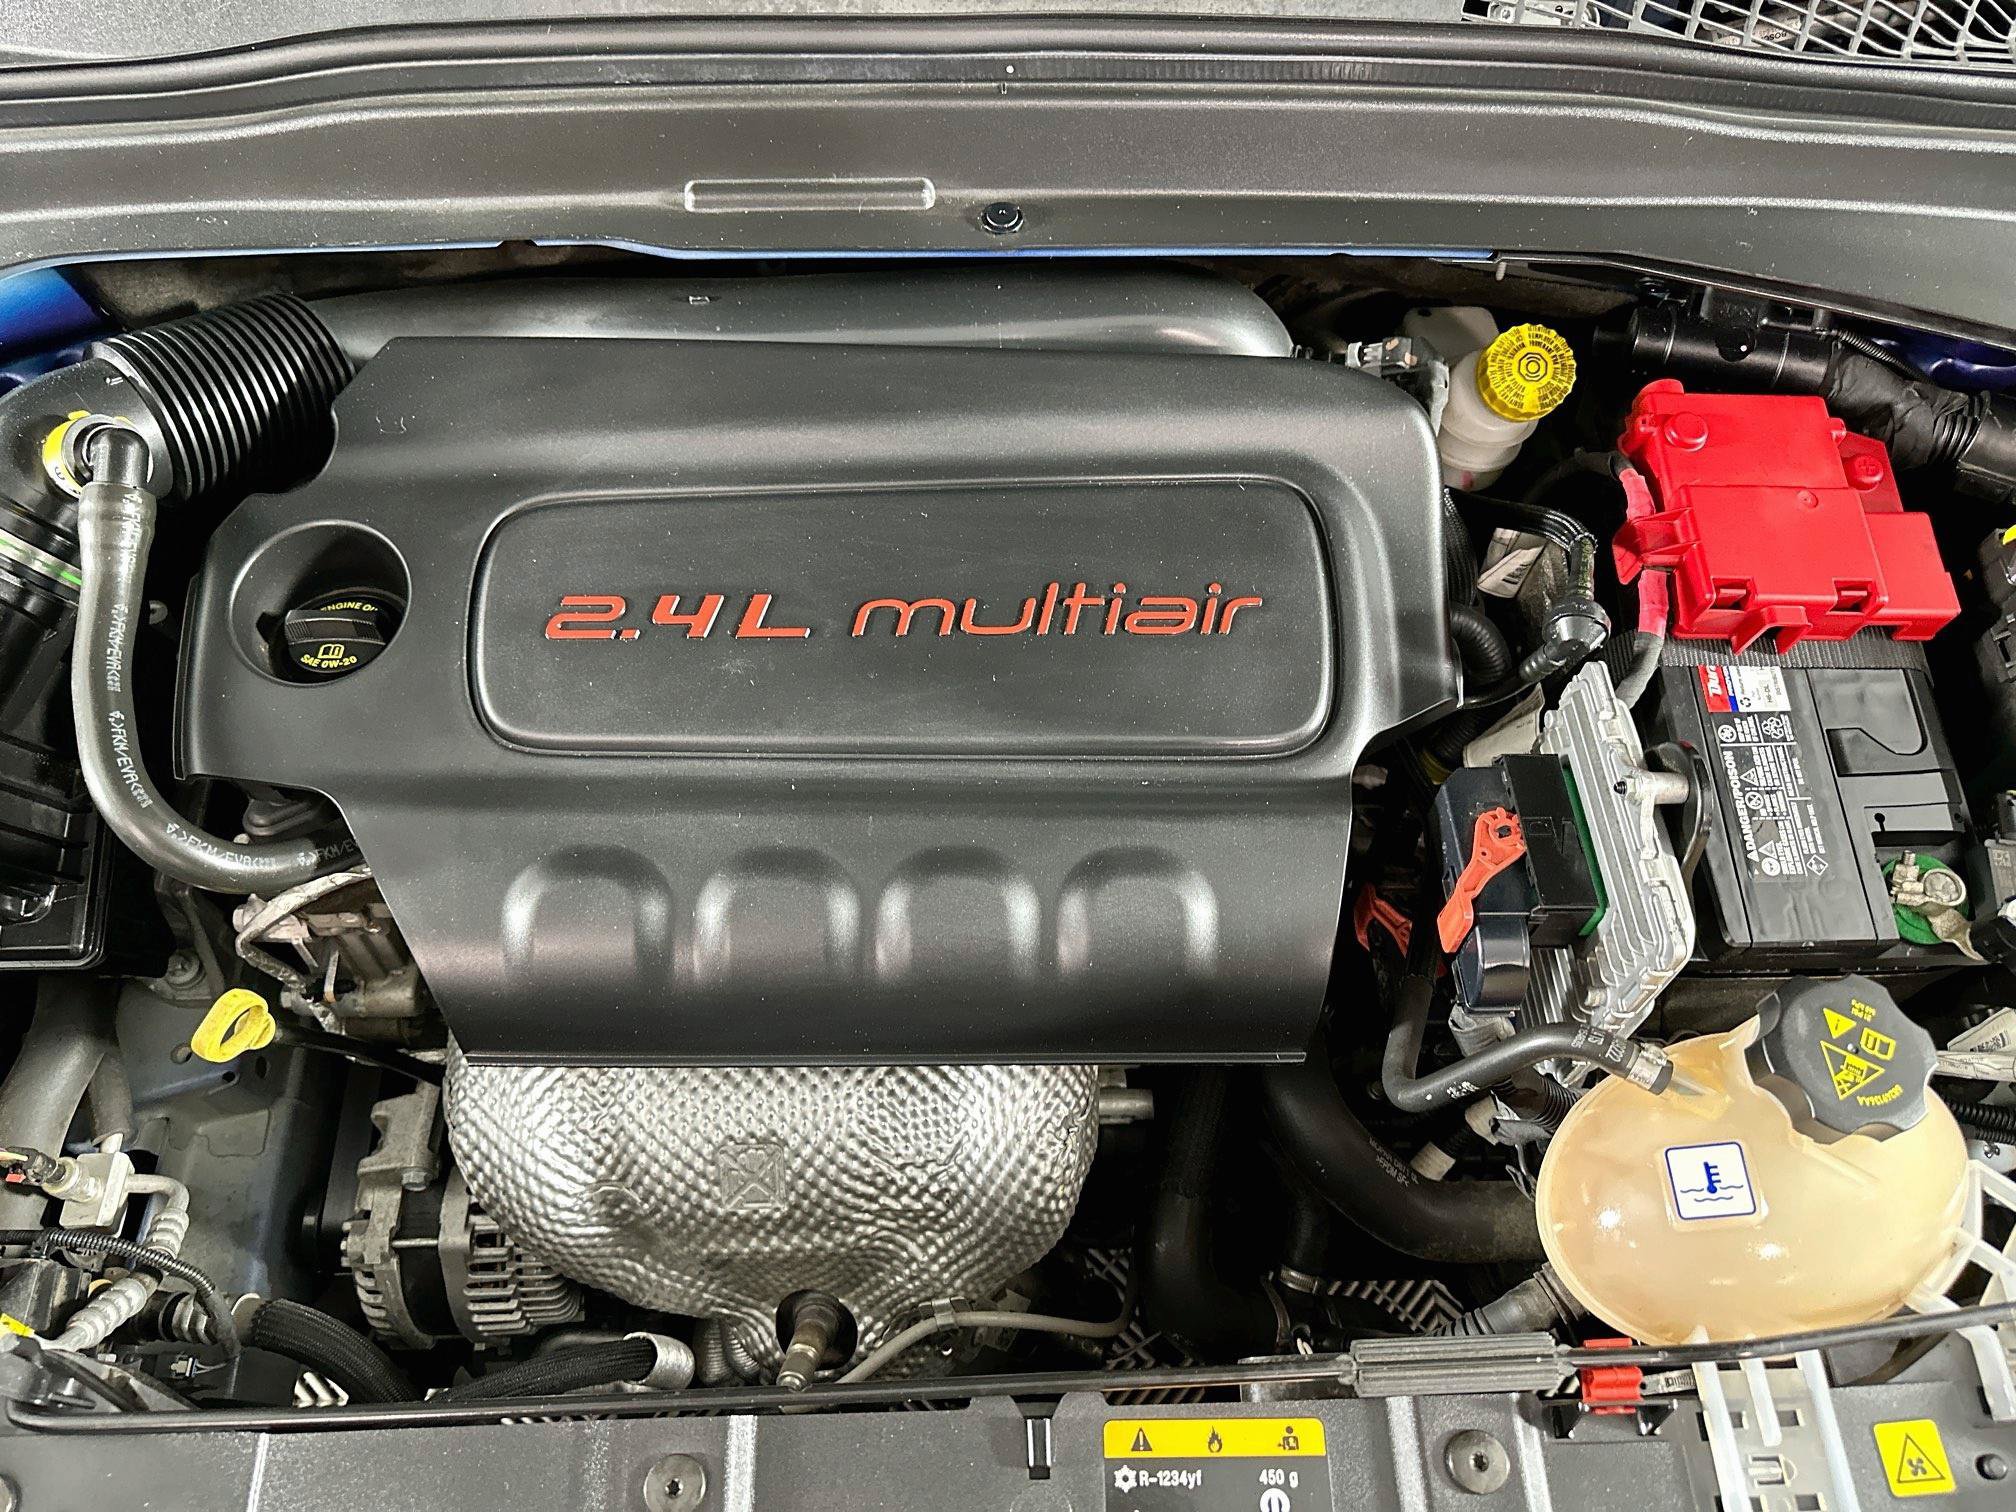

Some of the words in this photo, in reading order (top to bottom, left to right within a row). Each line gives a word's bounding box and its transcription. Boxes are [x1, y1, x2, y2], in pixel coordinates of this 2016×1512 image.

[852, 582, 1263, 636] multiair
[300, 653, 321, 667] SAE
[321, 655, 358, 669] 0W-20
[1722, 750, 1757, 851] DANGER/POISON
[1259, 1468, 1285, 1485] 450
[1289, 1471, 1298, 1488] g
